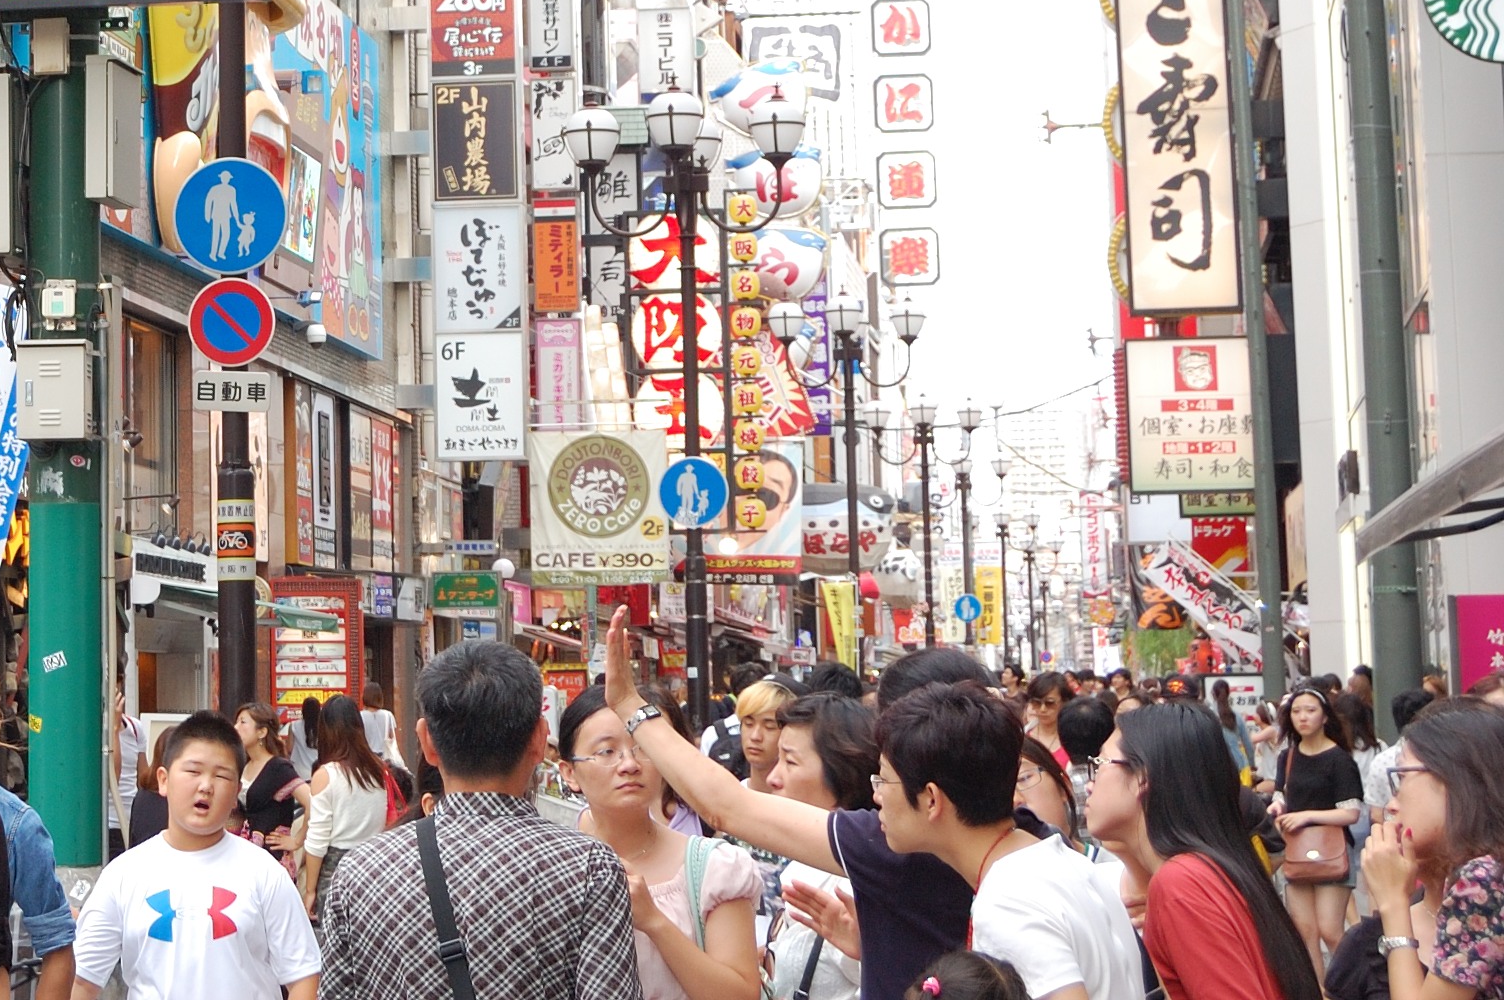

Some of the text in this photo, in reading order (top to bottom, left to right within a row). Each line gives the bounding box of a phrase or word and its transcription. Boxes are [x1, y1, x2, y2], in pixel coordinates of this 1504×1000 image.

[463, 60, 483, 75] 3F
[437, 88, 460, 104] 2F
[462, 86, 492, 195] 山内農場
[549, 224, 563, 293] ミティラー
[505, 317, 520, 327] 2F
[441, 342, 466, 361] 6F
[197, 380, 267, 403] 自動車
[456, 424, 506, 433] DOMA-DOMA
[557, 443, 641, 482] DOUTONBORI
[557, 498, 642, 533] ZERO Cafe
[643, 520, 664, 536] 2F
[1193, 523, 1236, 538] ドラッグ
[535, 552, 596, 568] CAFE
